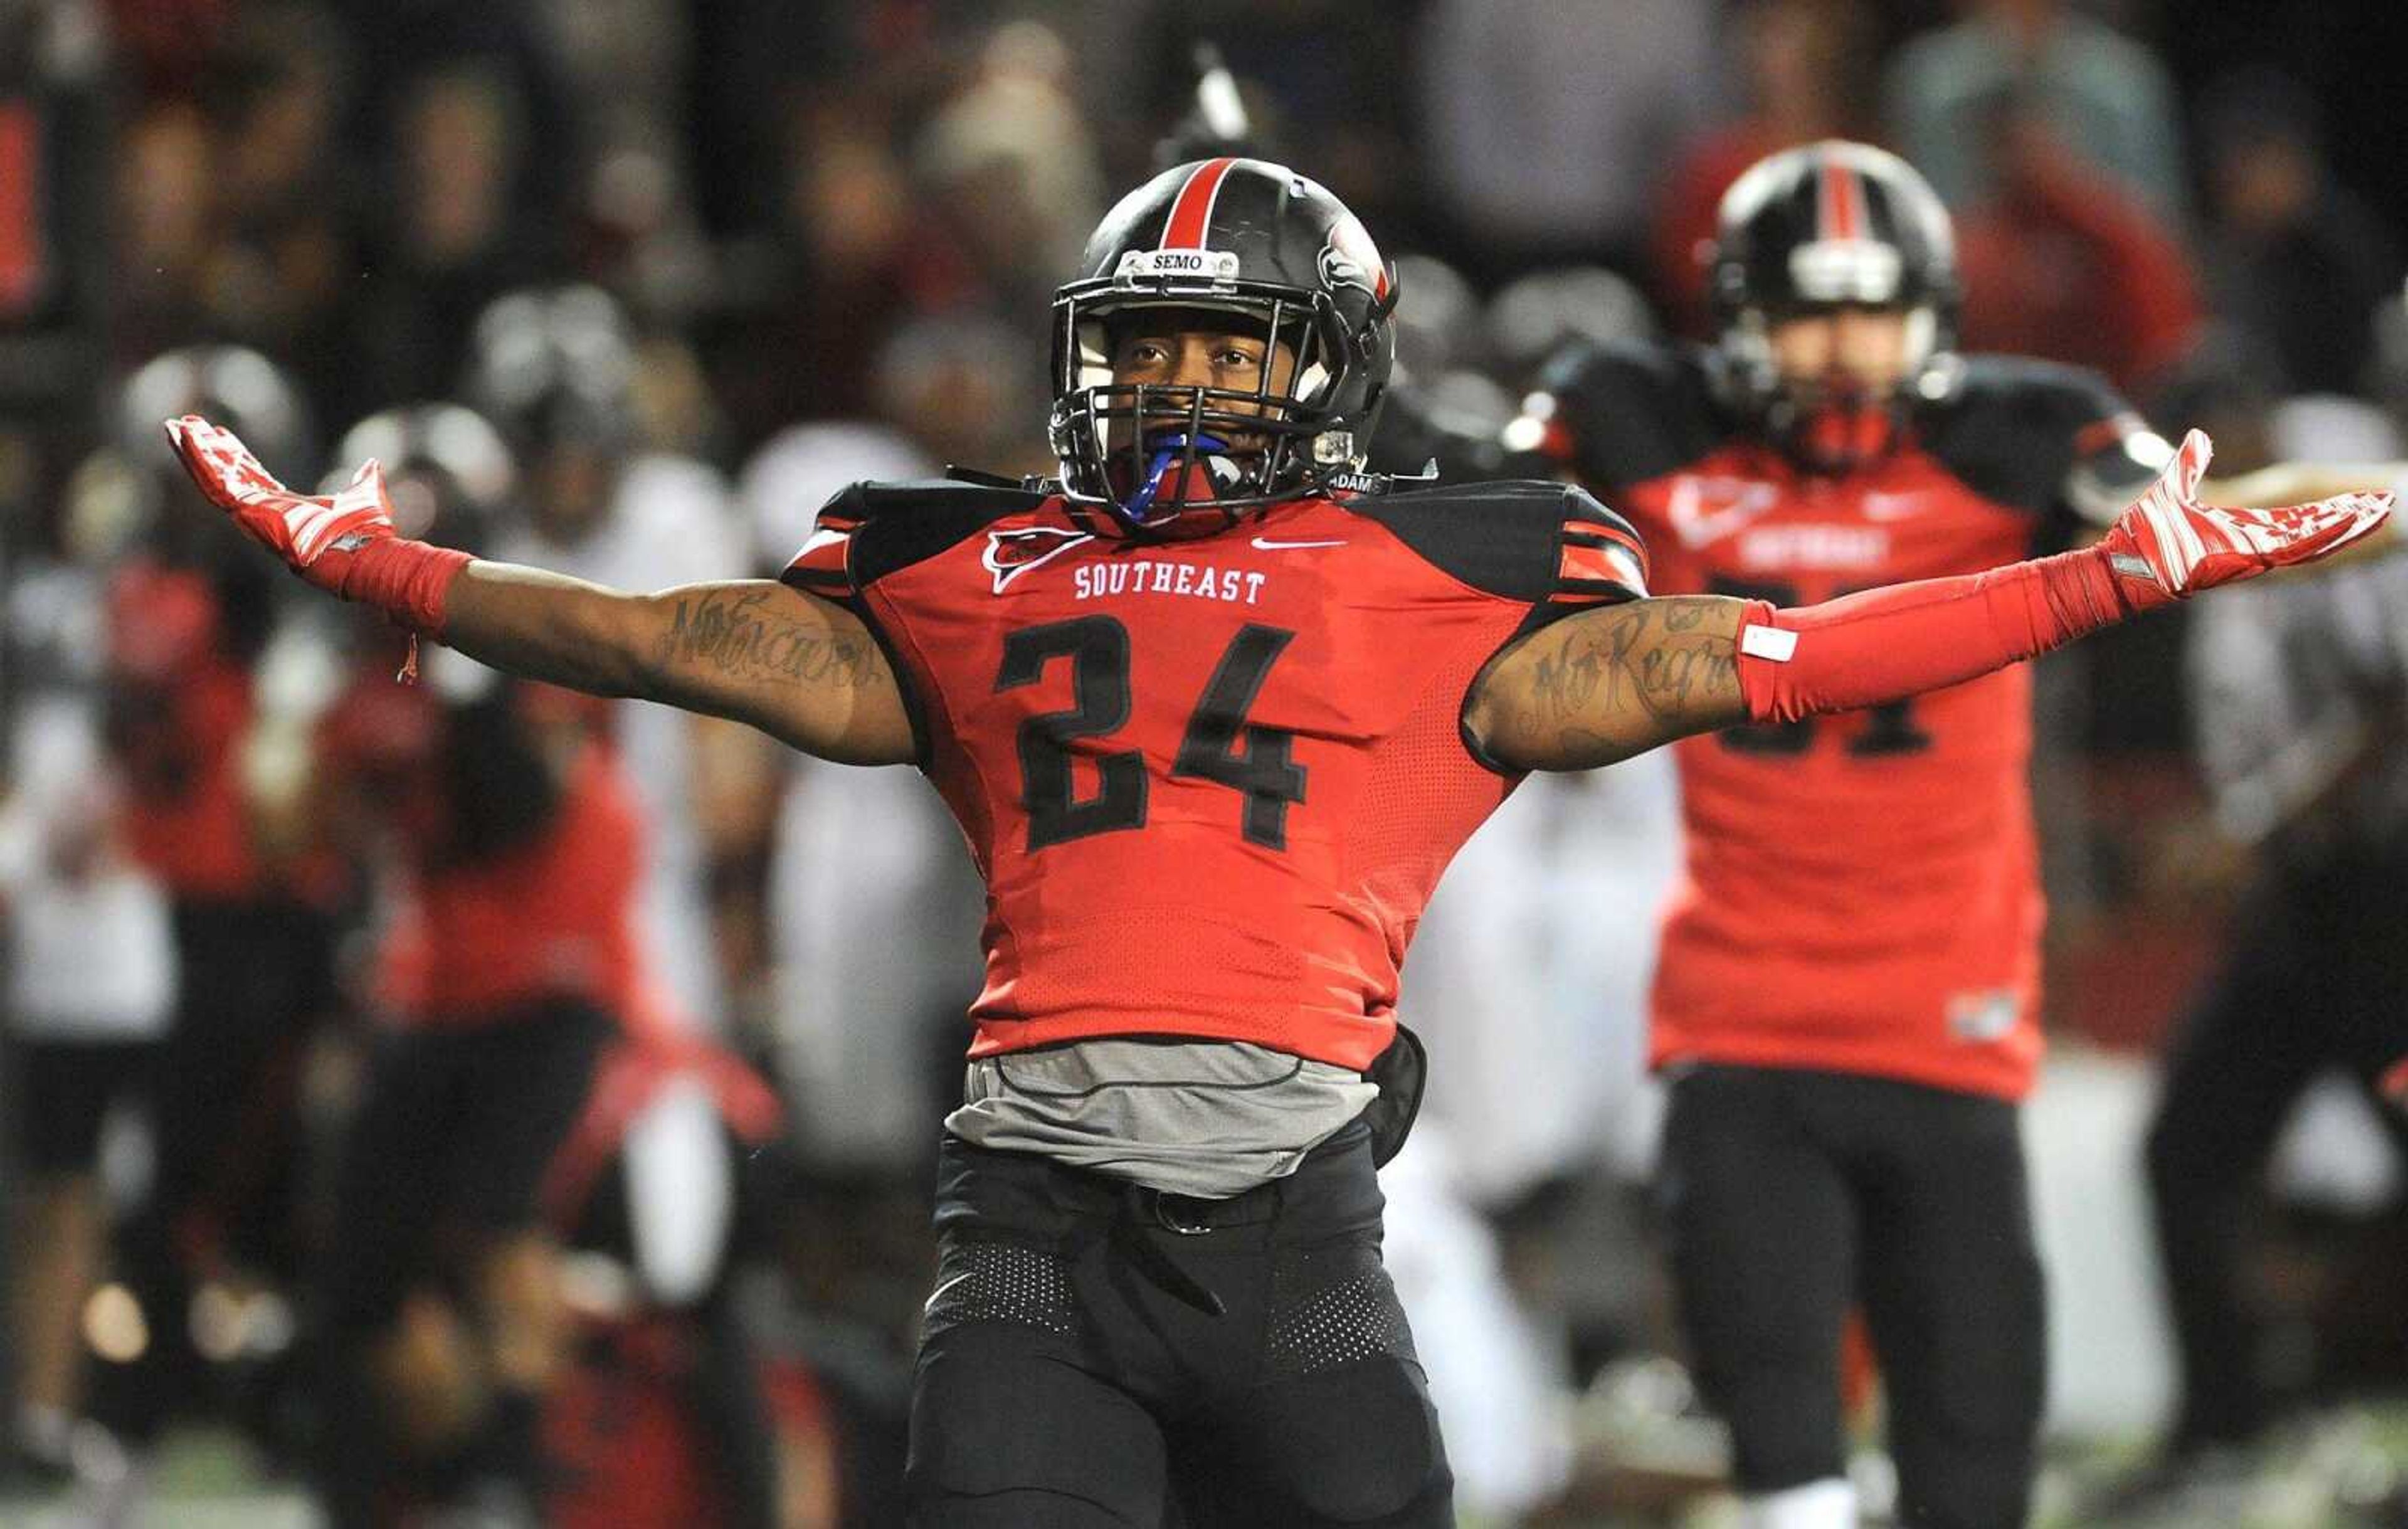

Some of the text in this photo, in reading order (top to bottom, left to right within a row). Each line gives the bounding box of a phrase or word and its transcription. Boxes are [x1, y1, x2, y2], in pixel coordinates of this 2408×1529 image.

[1153, 255, 1202, 270] SEMO
[1075, 561, 1265, 604] SOUTHEAST
[993, 613, 1307, 853] 24
